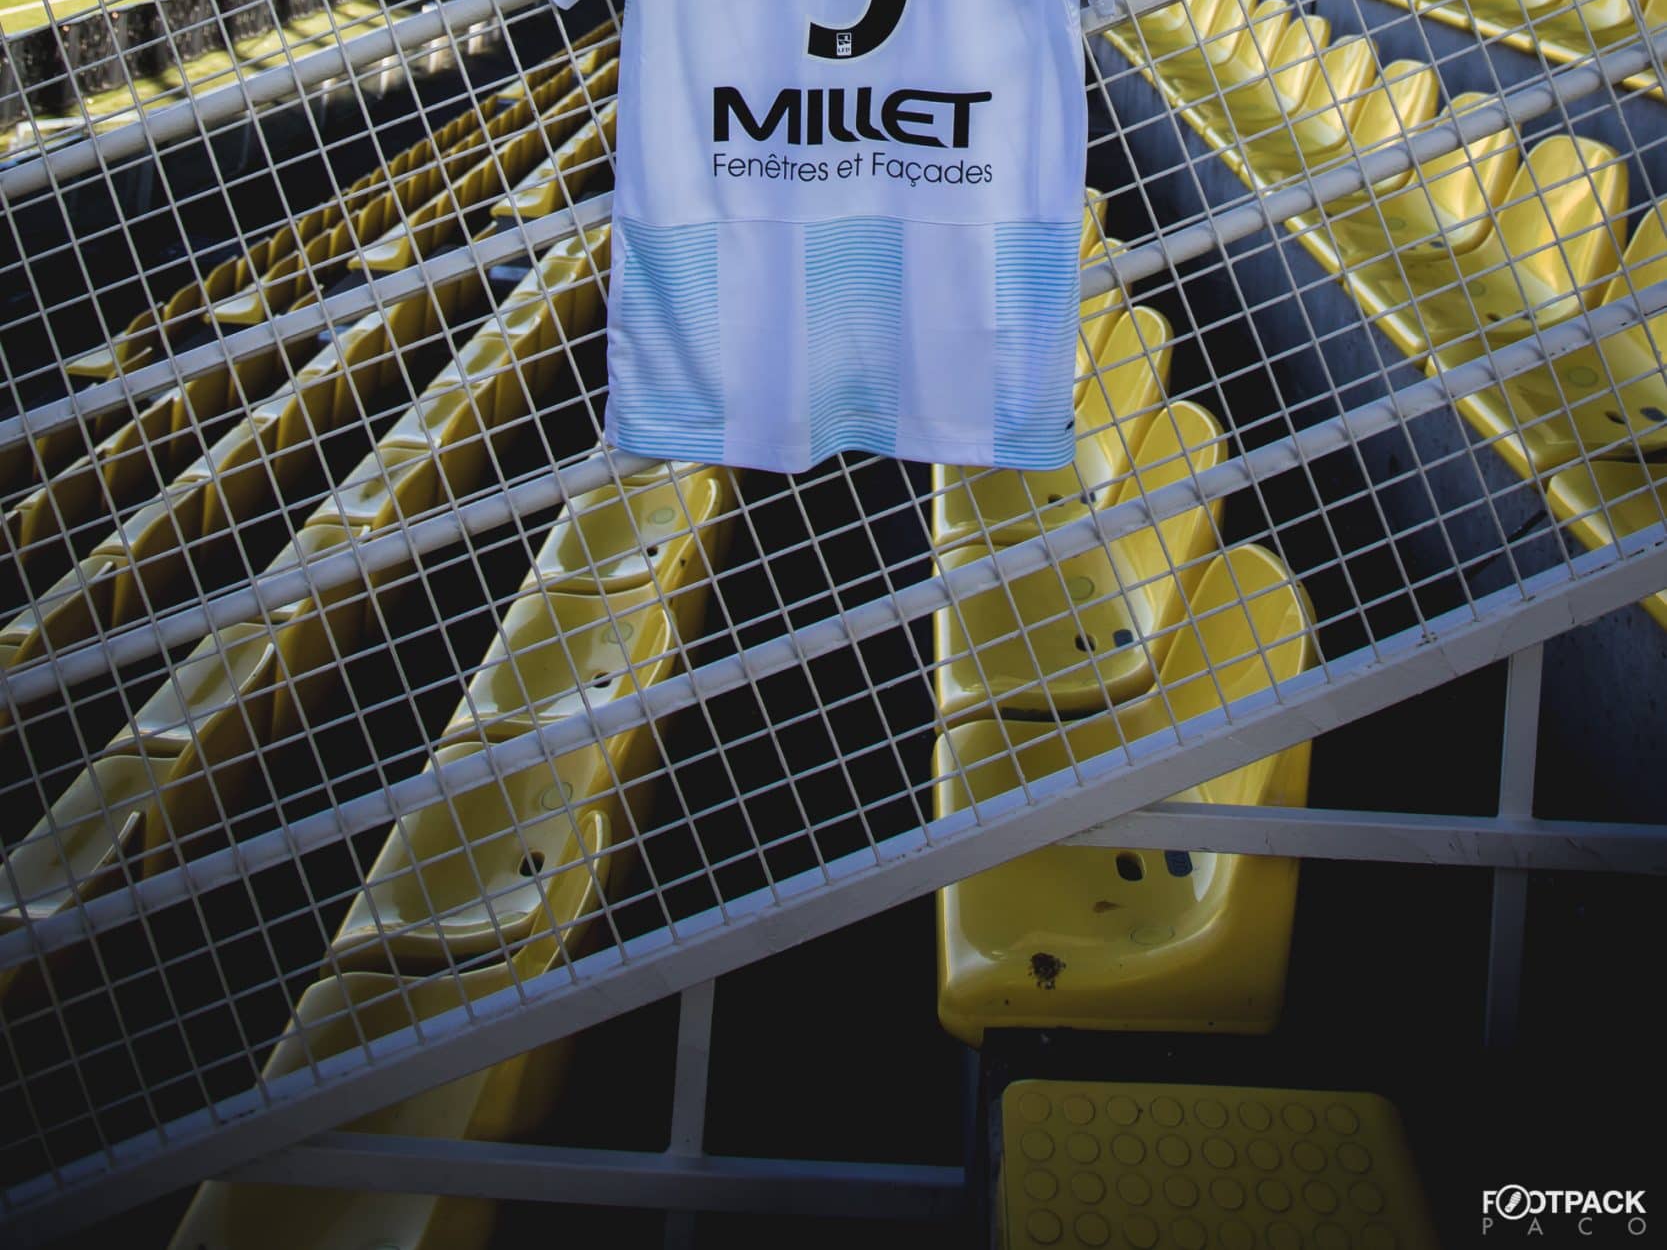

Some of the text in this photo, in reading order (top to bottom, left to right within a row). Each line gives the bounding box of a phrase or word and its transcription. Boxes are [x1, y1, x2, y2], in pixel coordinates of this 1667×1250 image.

[713, 86, 993, 149] MILLET
[713, 152, 993, 188] Fenêtres et Façades
